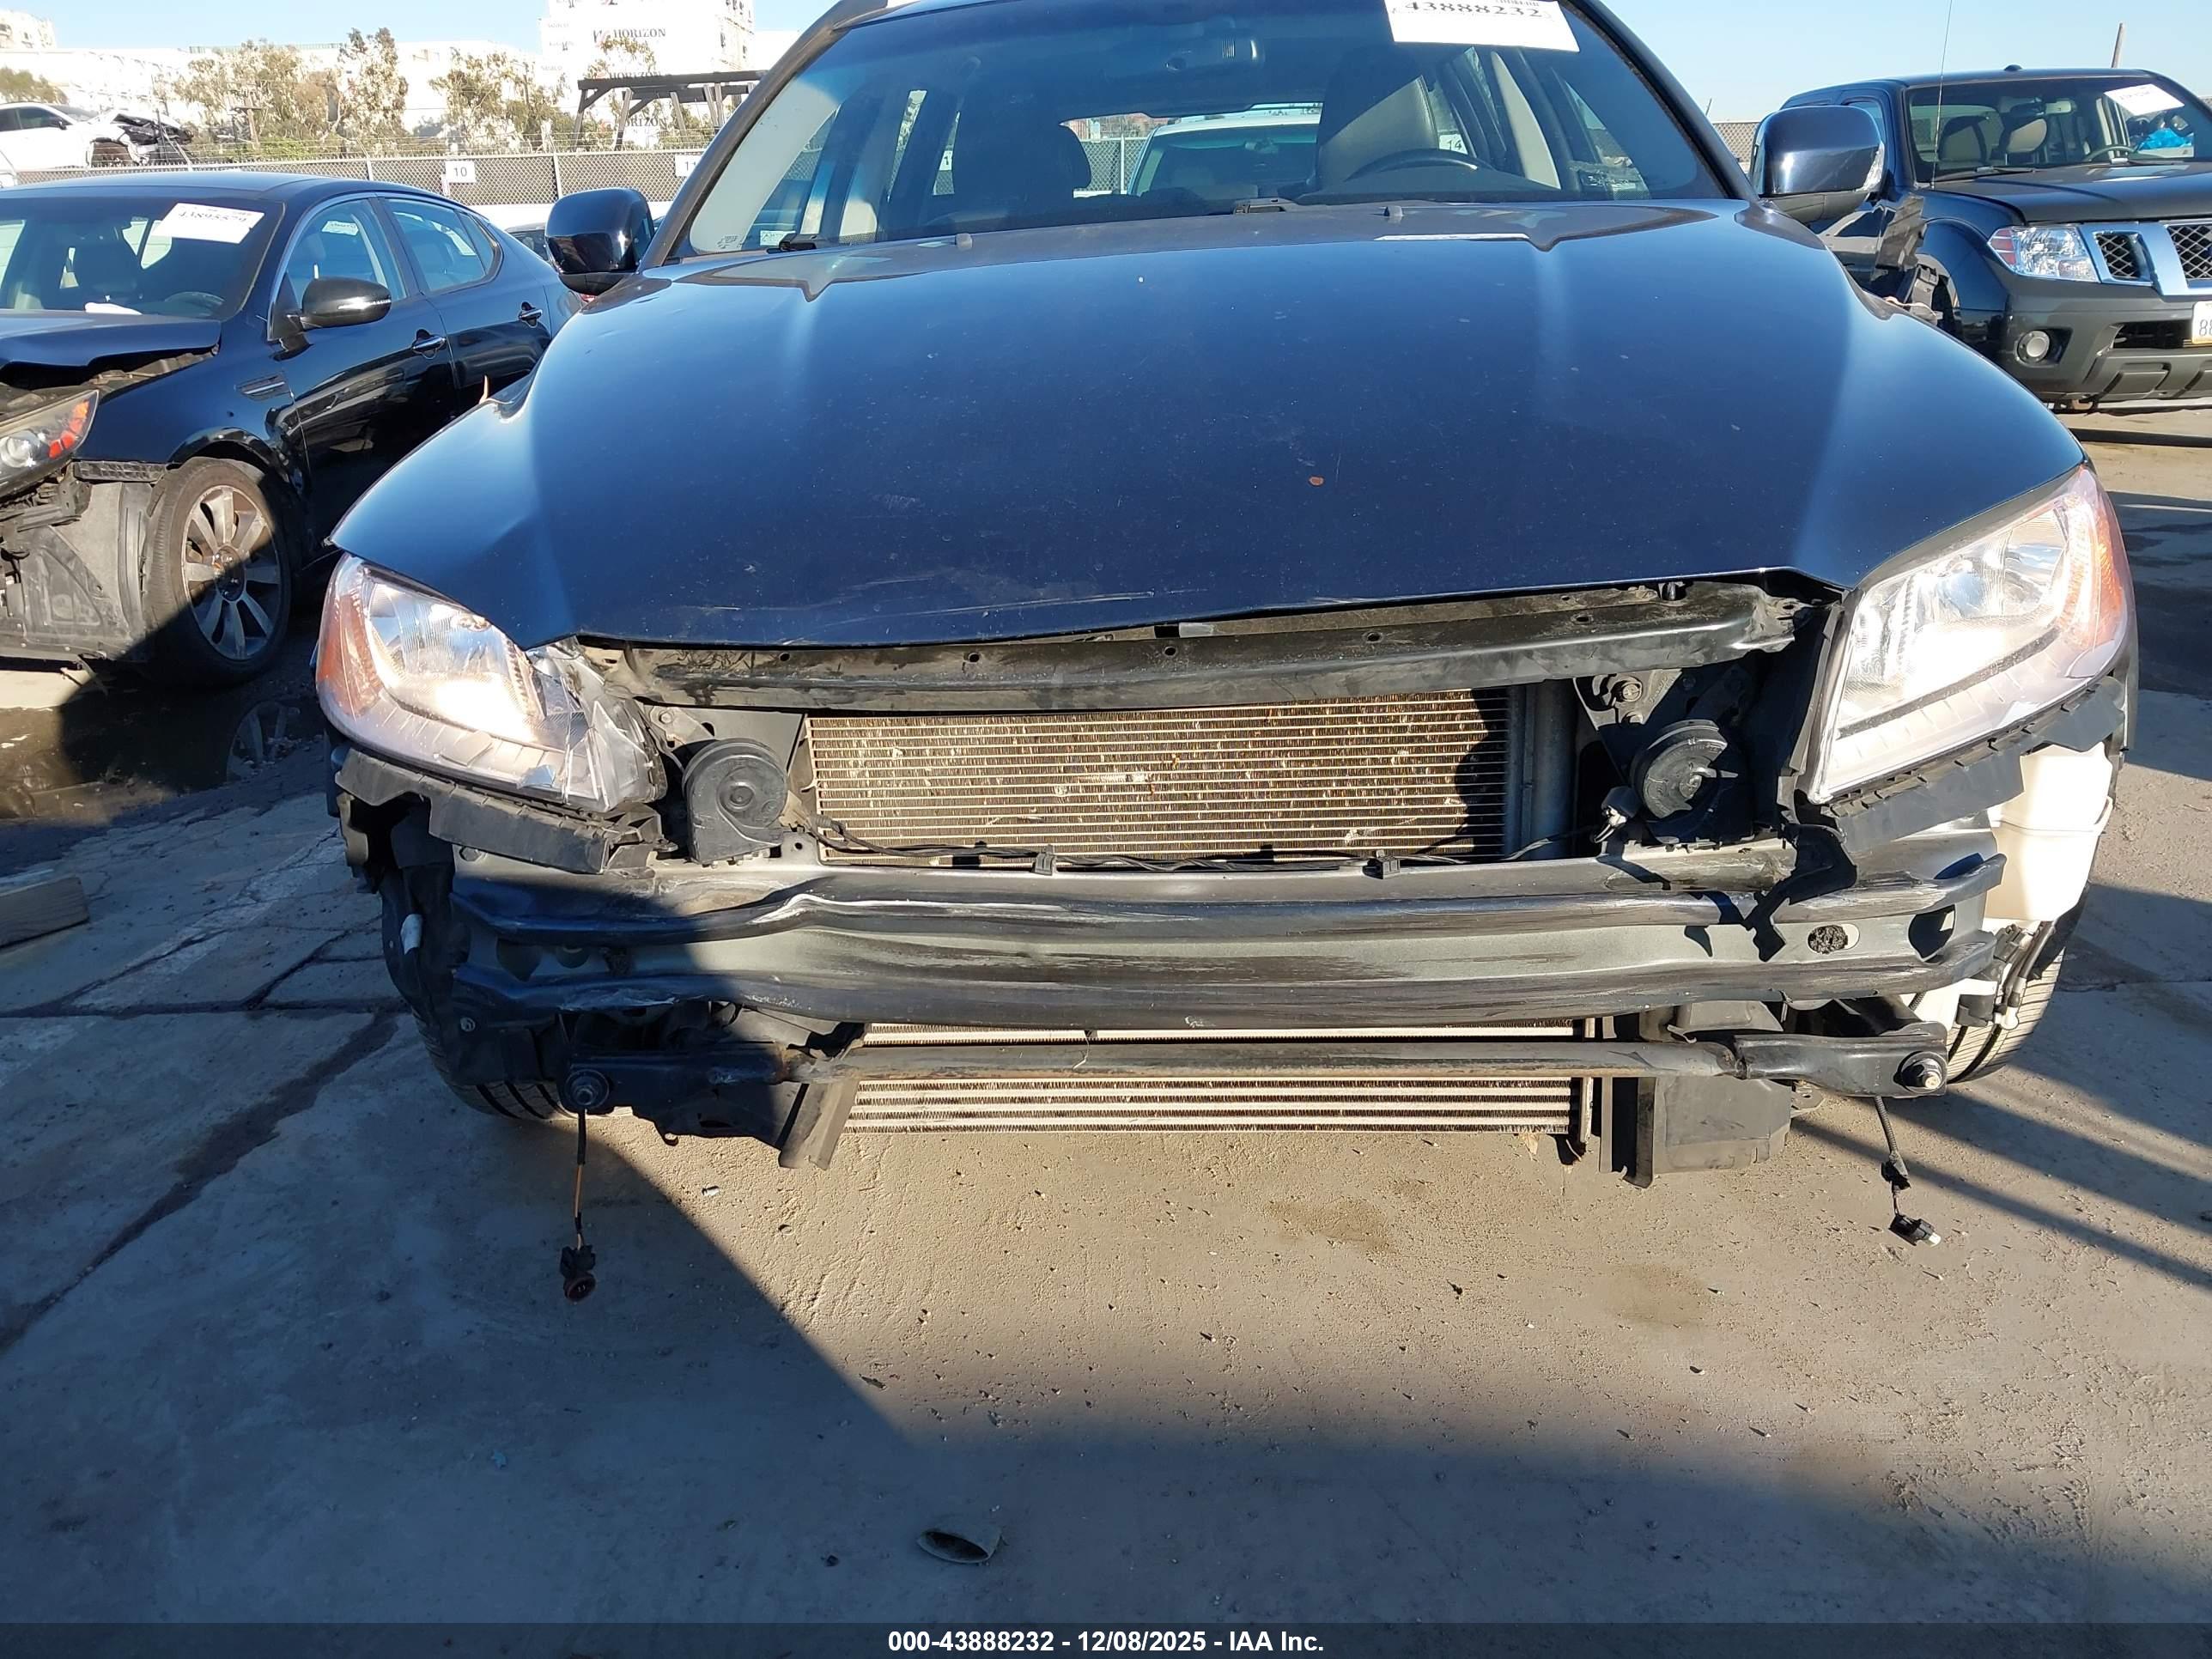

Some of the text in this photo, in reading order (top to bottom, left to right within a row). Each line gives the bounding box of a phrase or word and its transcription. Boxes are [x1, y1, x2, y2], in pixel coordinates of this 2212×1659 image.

[1405, 1, 1542, 17] 43888232
[613, 28, 665, 38] HORIZON
[1446, 139, 1462, 150] 14
[453, 167, 468, 177] 10
